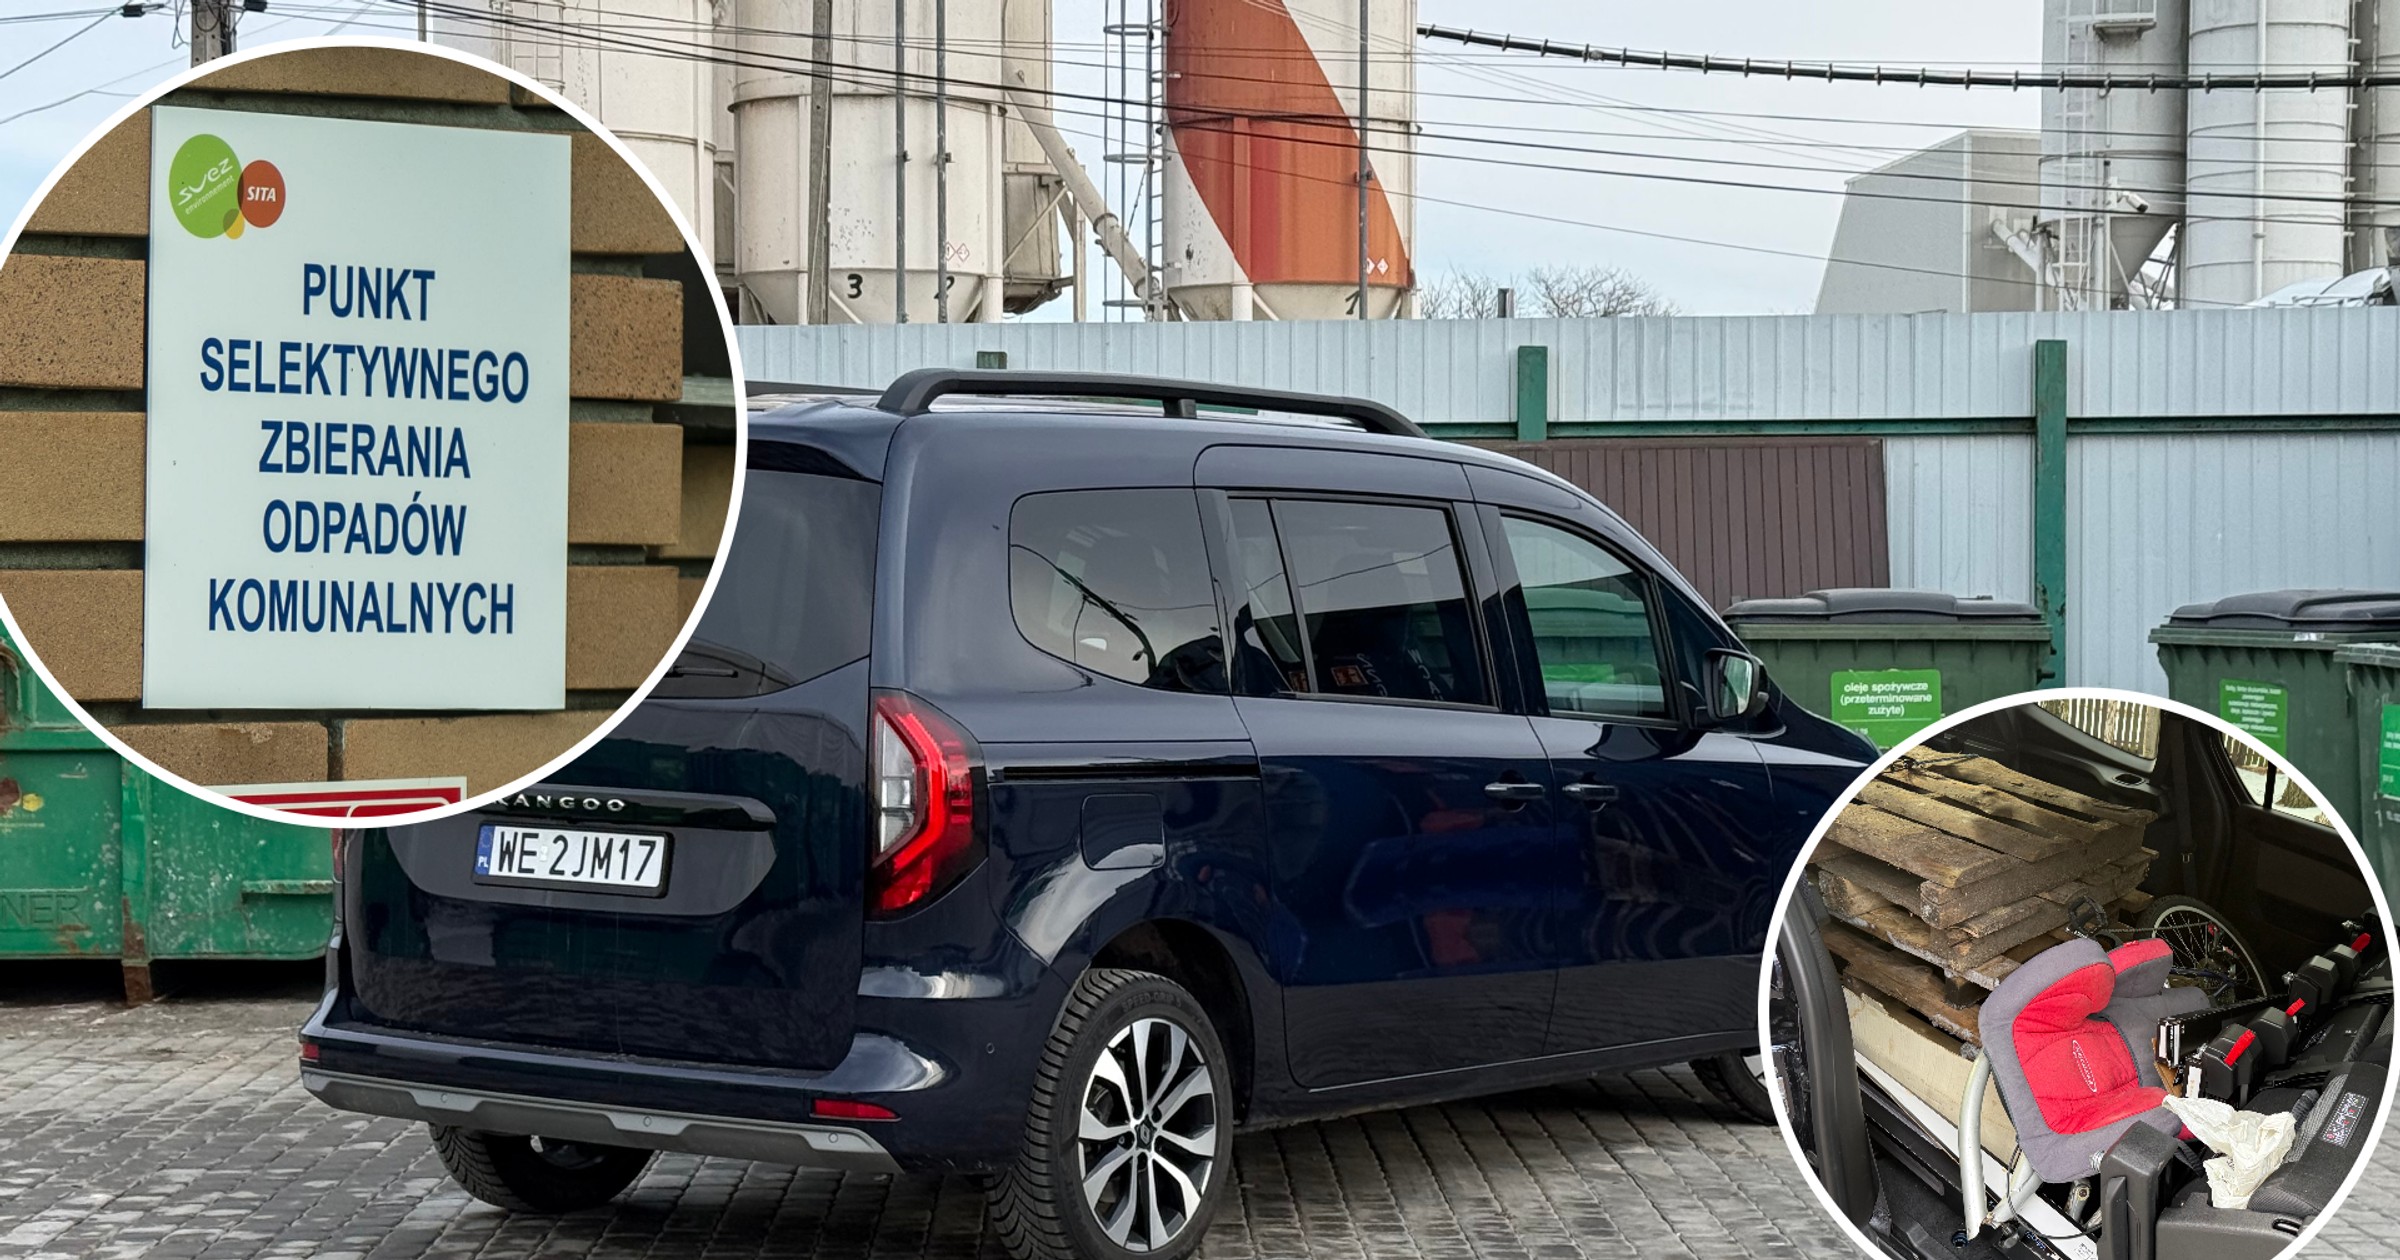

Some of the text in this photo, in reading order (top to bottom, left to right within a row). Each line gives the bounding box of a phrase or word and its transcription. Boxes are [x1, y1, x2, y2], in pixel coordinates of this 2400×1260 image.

[185, 175, 235, 215] environnement
[247, 186, 276, 202] SITA
[303, 263, 435, 321] PUNKT
[847, 273, 863, 299] 3
[200, 337, 530, 404] SELEKTYWNEGO
[259, 420, 471, 479] ZBIERANIA
[263, 491, 467, 557] ODPADÓW
[208, 578, 514, 634] KOMUNALNYCH
[1840, 693, 1933, 706] (przeterminowane
[1844, 681, 1929, 694] oleje spożywcze
[1868, 705, 1904, 717] zużyte)
[477, 855, 489, 868] PL
[498, 831, 656, 881] WE 2JM17
